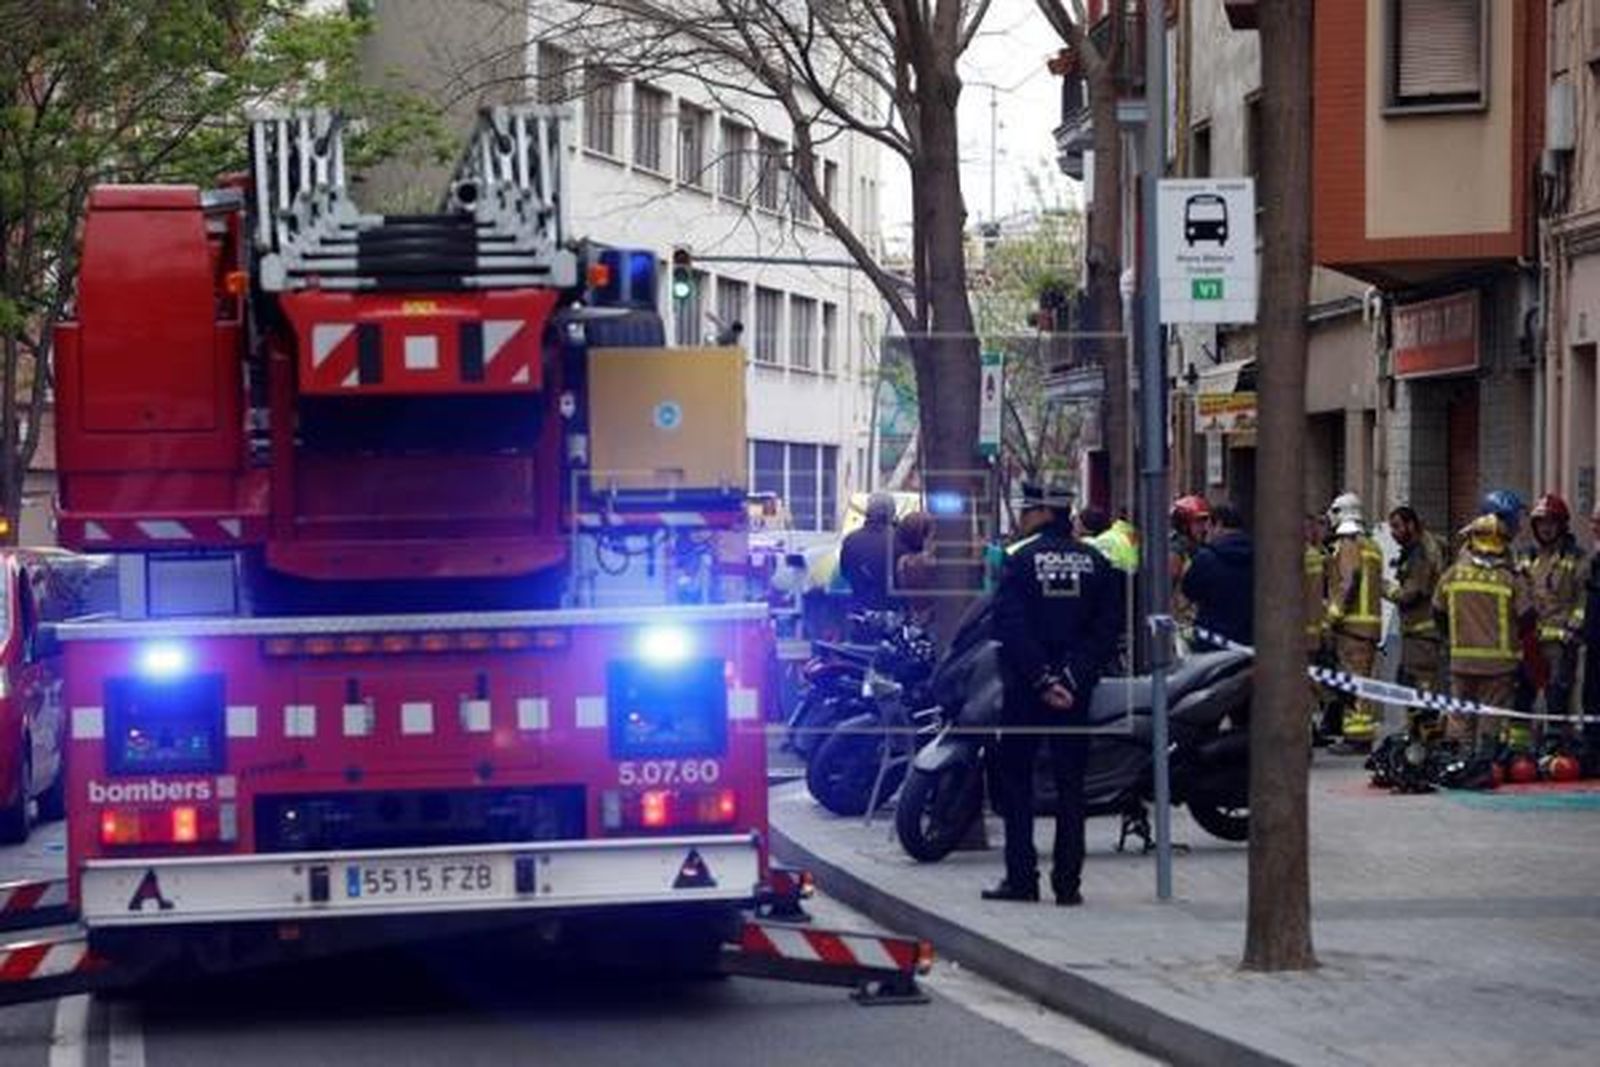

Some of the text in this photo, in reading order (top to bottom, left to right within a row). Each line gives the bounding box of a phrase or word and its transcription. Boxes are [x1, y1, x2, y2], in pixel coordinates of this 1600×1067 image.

[1199, 282, 1218, 298] V1
[618, 759, 720, 785] 5.07.60
[88, 778, 210, 803] bombers
[363, 864, 492, 895] 5515 FZB
